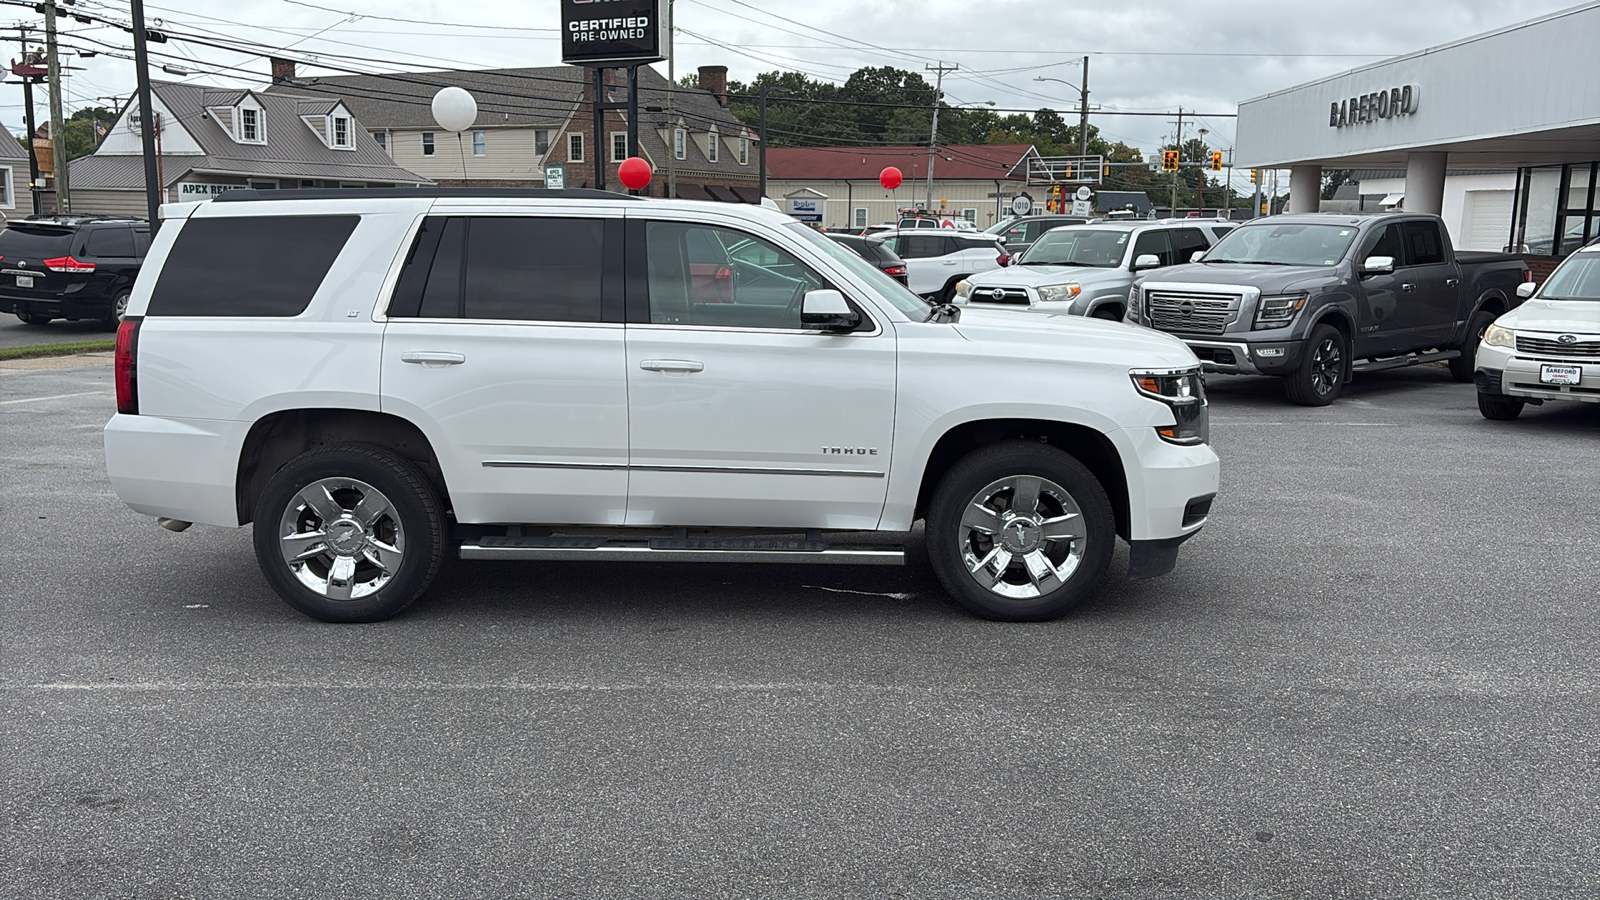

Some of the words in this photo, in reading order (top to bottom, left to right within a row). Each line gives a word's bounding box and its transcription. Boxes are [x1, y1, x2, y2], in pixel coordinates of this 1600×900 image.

[569, 17, 649, 32] CERTIFIED
[573, 28, 645, 42] PRE-OWNED
[1329, 84, 1420, 128] BAREFORD
[182, 184, 208, 194] APEX
[1014, 201, 1028, 209] 1010
[820, 445, 878, 456] TAHOE
